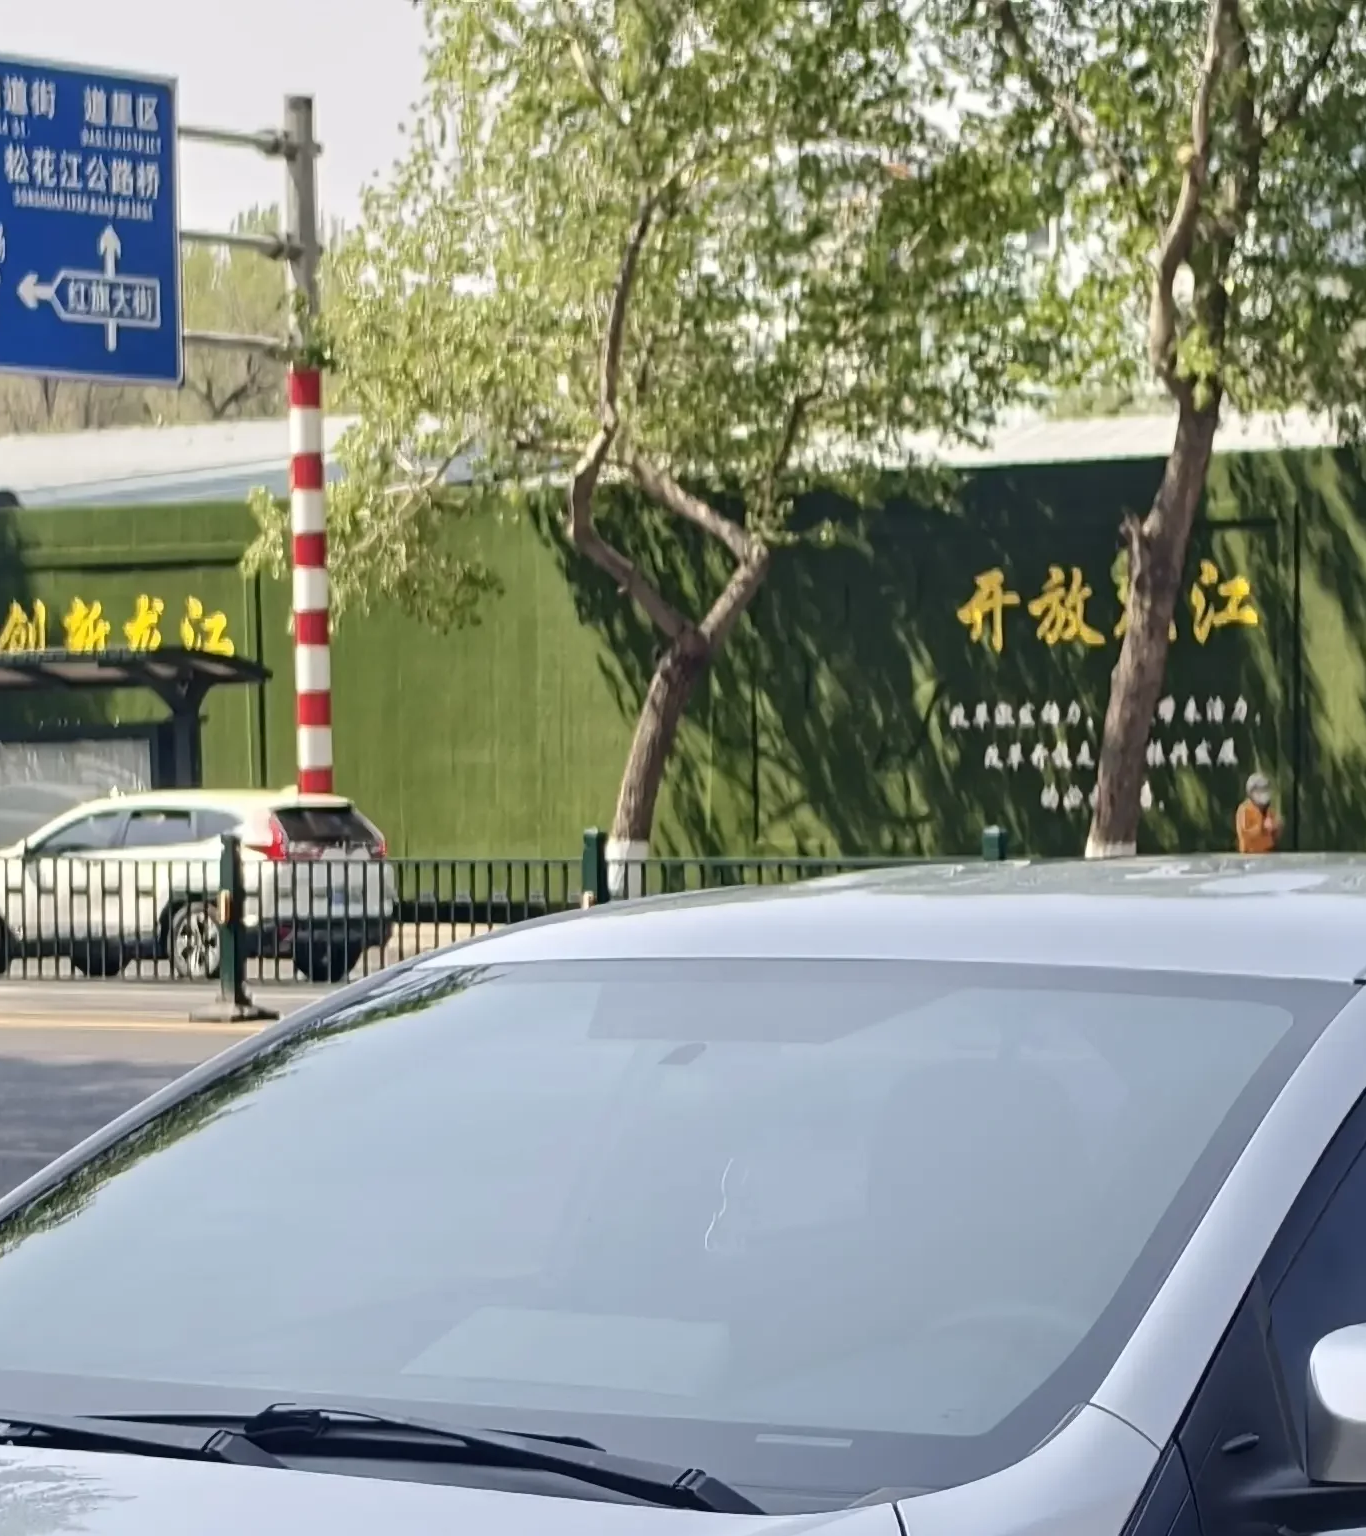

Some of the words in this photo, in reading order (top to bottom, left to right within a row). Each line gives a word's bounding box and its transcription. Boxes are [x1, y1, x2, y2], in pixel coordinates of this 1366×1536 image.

[4, 142, 158, 200] 松花江公路桥
[68, 278, 152, 320] 红旗大街
[956, 560, 1259, 652] 开放江
